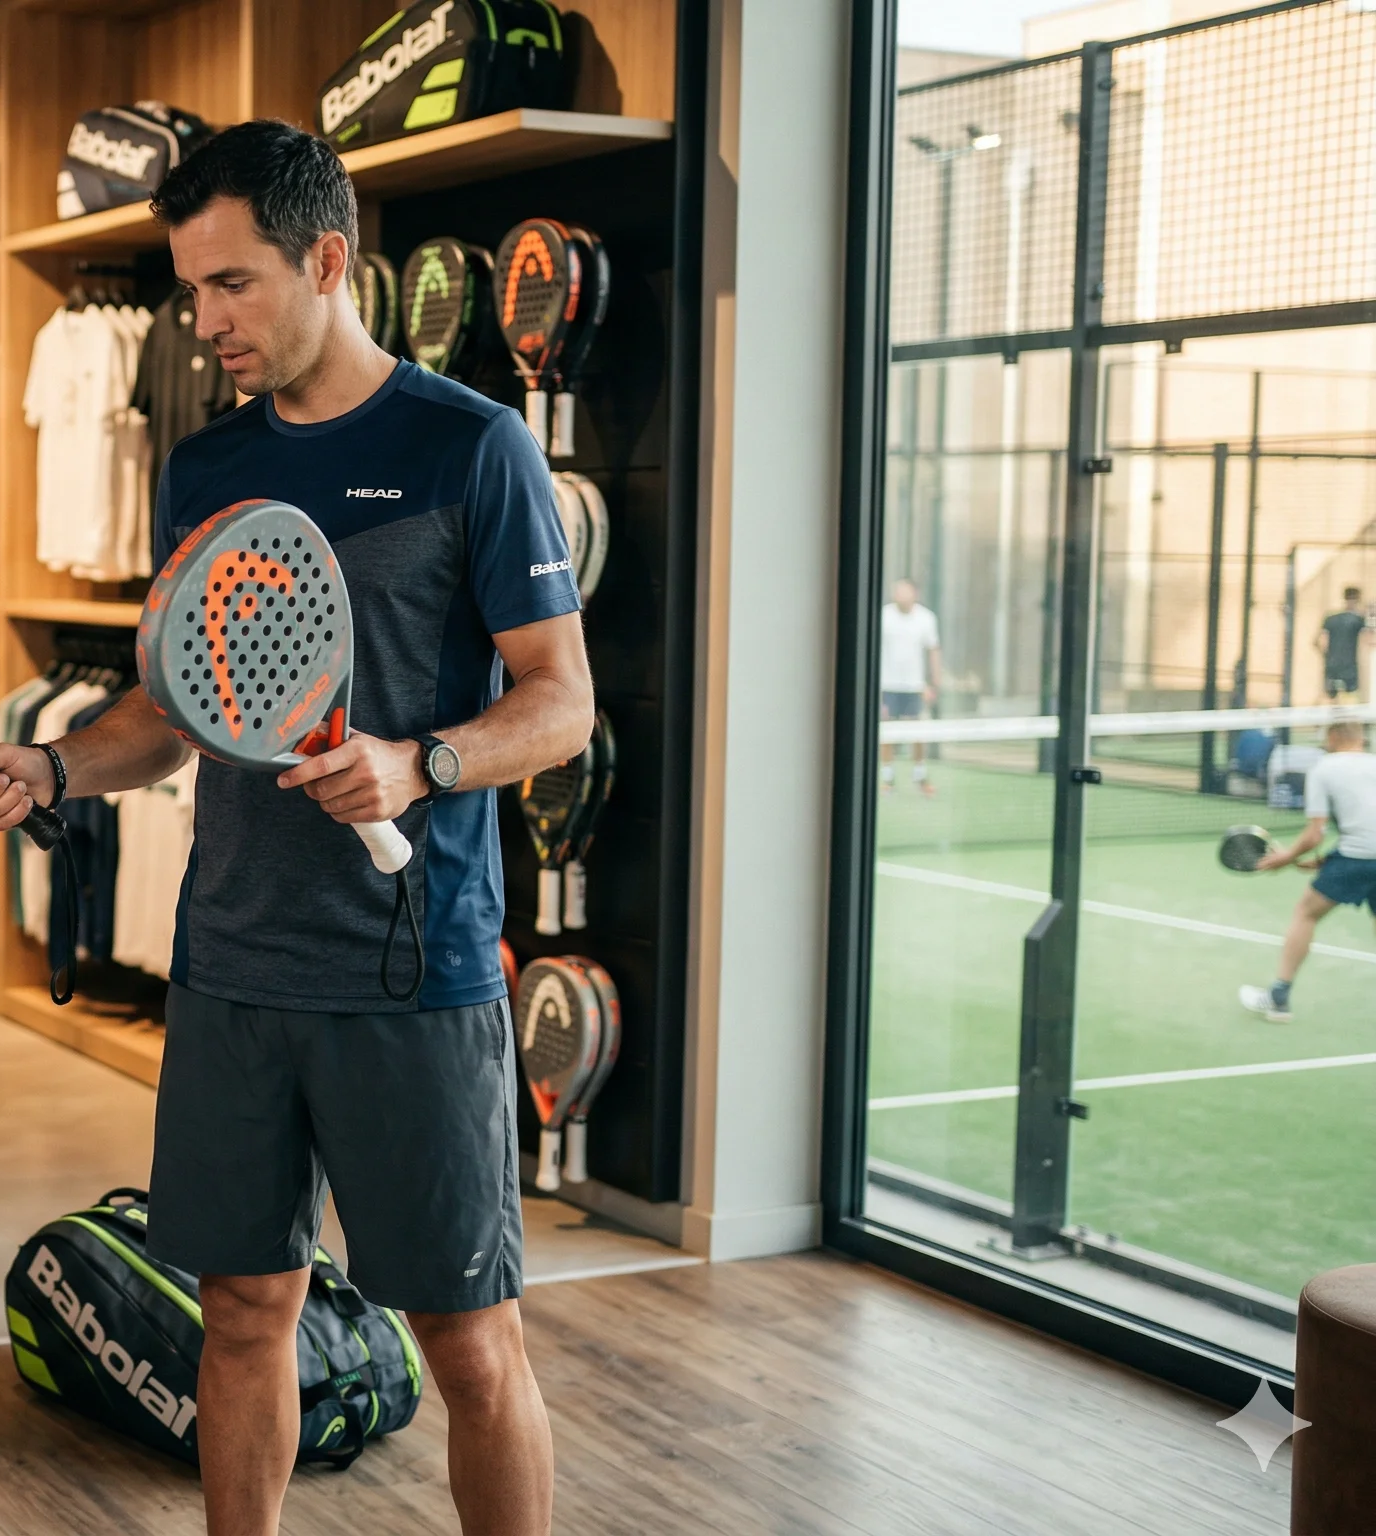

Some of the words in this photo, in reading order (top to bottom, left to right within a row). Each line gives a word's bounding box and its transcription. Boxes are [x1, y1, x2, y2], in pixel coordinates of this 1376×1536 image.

[321, 0, 455, 135] Babolat
[345, 488, 403, 499] HEAD
[26, 1244, 198, 1440] Babolat
